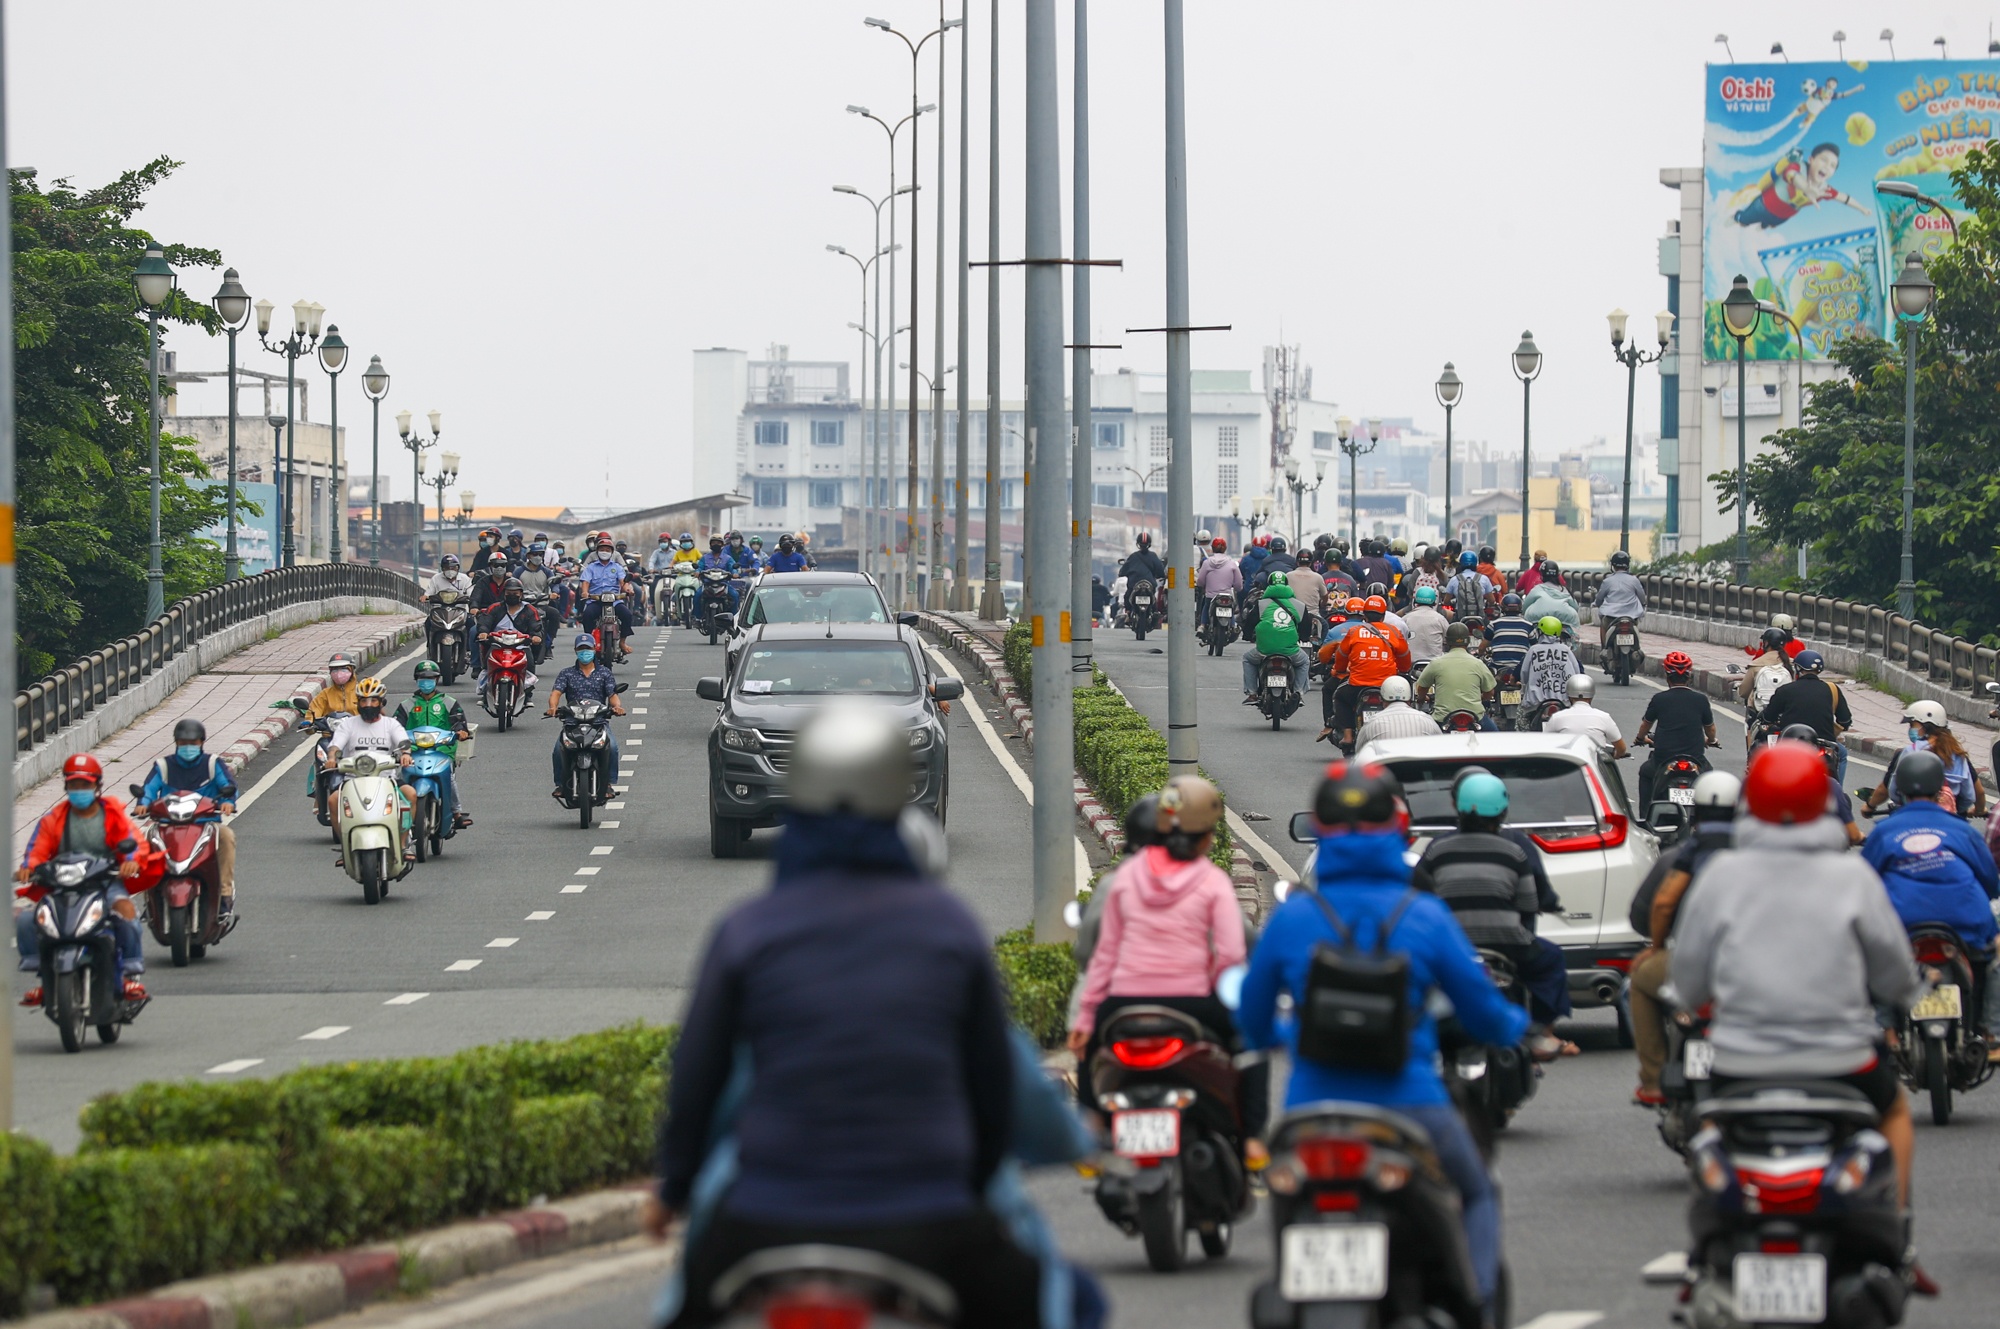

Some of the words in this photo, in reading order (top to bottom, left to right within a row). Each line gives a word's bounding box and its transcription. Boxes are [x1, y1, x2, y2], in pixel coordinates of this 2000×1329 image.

[1721, 77, 1774, 100] Oishi
[1957, 73, 2000, 97] TH
[1886, 135, 1917, 155] CHO
[1914, 214, 1955, 230] Oish
[1798, 264, 1822, 276] Oishi
[1804, 273, 1866, 299] Snack
[1431, 440, 1488, 463] ZEN
[1532, 649, 1569, 665] PEACE
[1533, 662, 1566, 673] wanted
[1541, 679, 1567, 695] FREE
[357, 737, 386, 745] GUCCI
